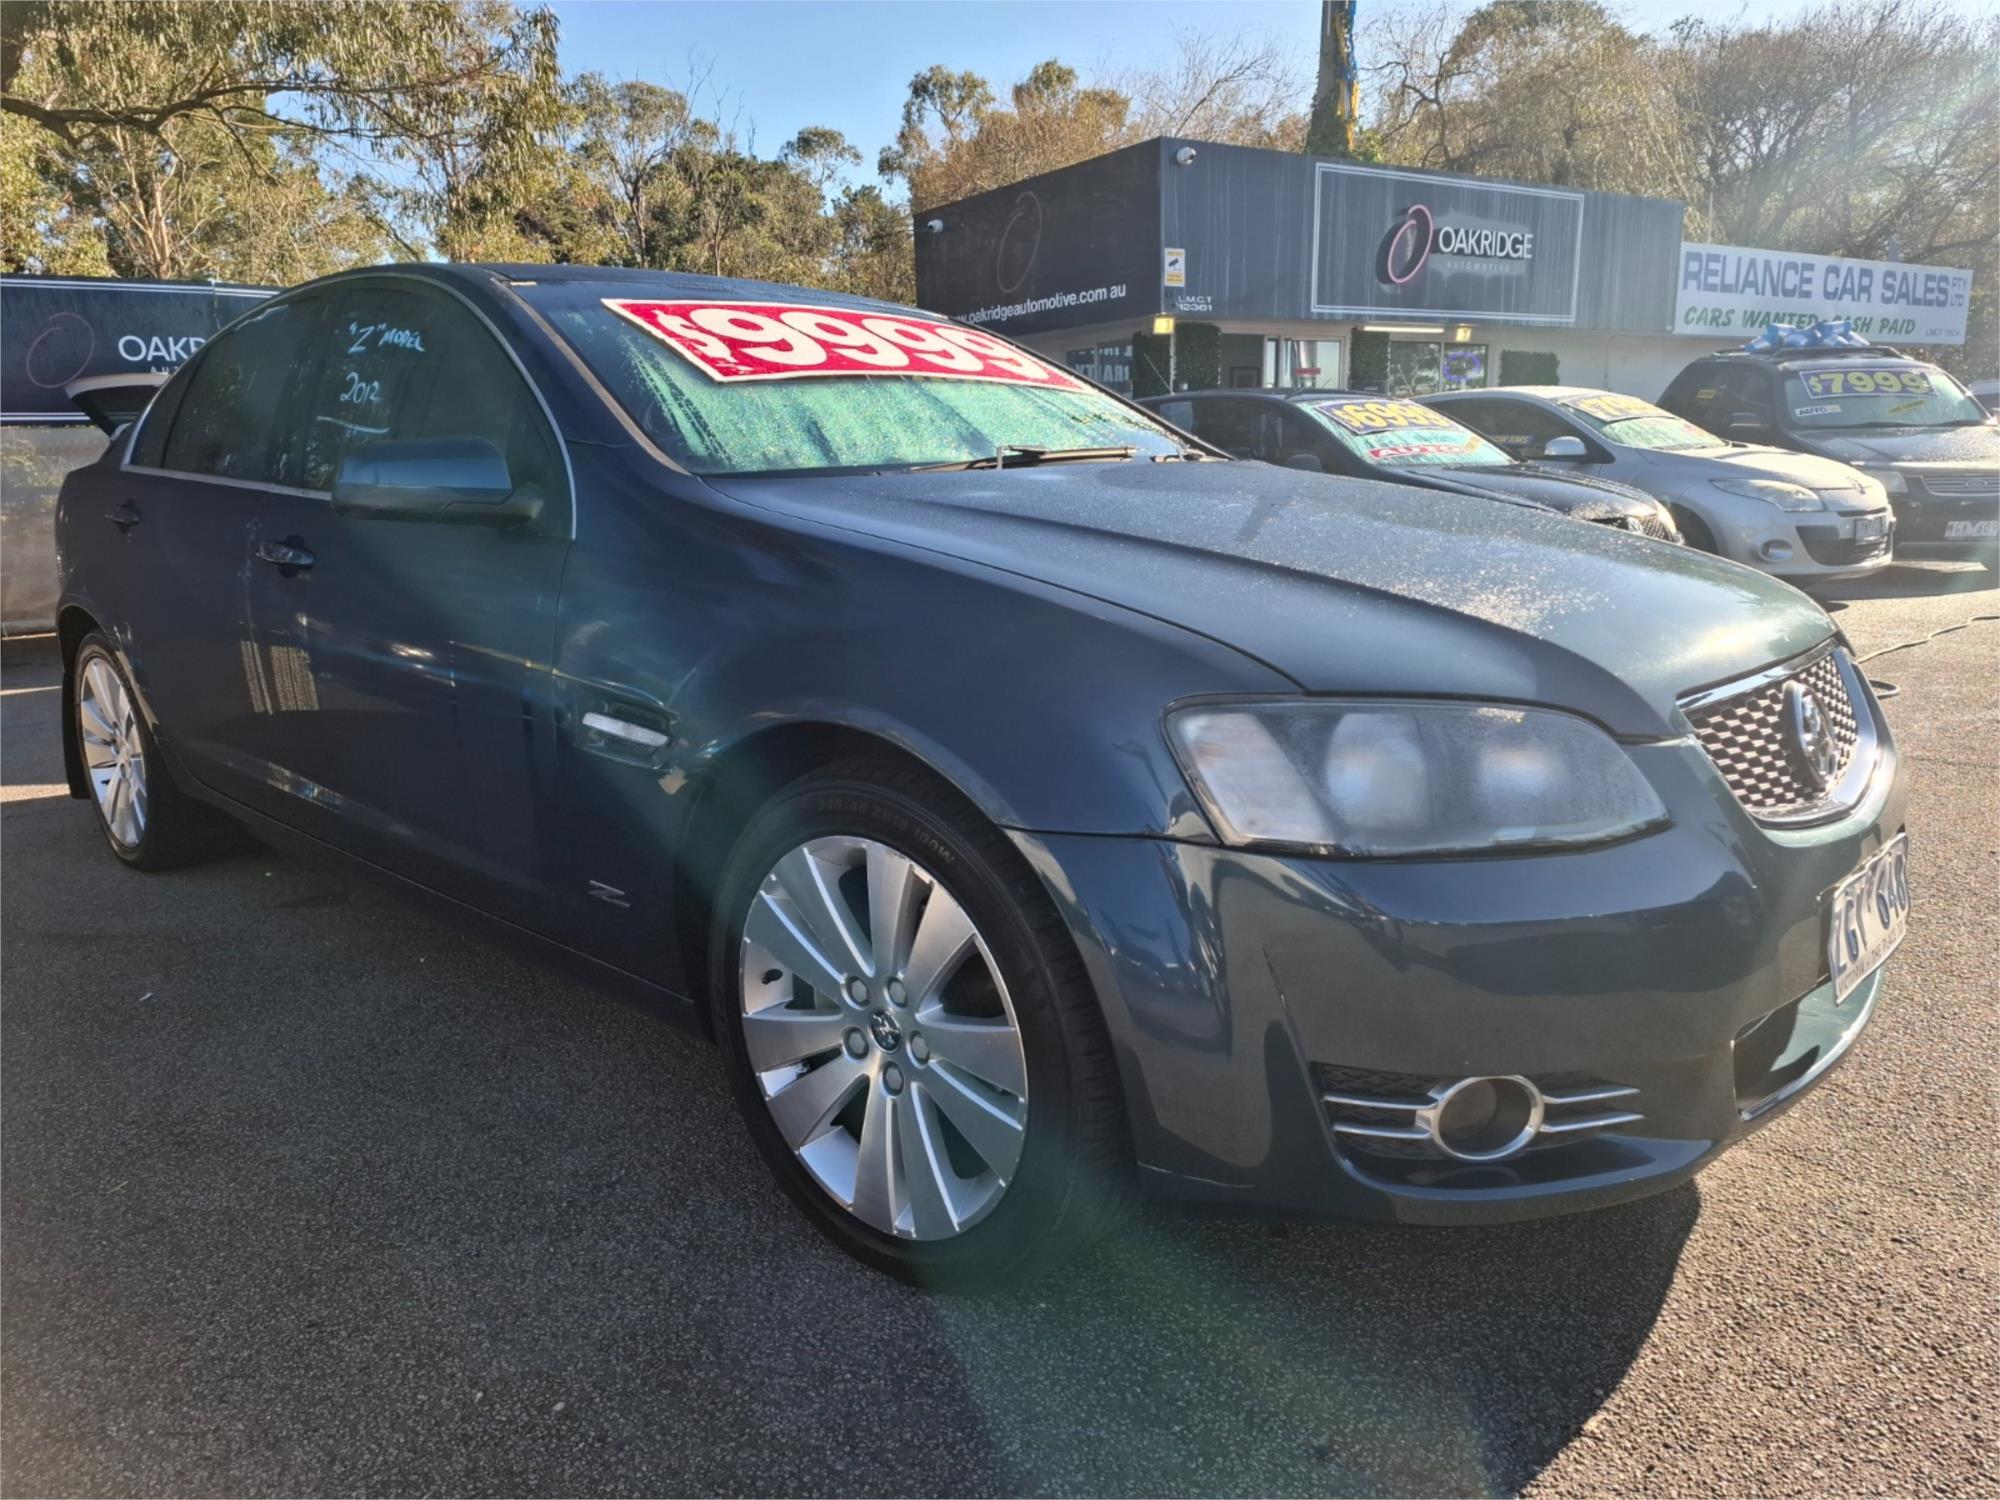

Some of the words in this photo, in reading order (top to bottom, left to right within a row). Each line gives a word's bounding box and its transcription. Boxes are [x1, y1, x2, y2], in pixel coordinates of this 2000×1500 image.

[1438, 226, 1534, 259] OAKRIDGE
[1682, 251, 1815, 299] RELIANCE
[1822, 264, 1874, 303] CAR
[1881, 270, 1949, 308] SALES
[1684, 306, 1735, 328] CARS
[1879, 317, 1916, 335] PAID
[650, 306, 1050, 381] $9999
[339, 371, 380, 405] 2012
[1808, 371, 1930, 395] $7999
